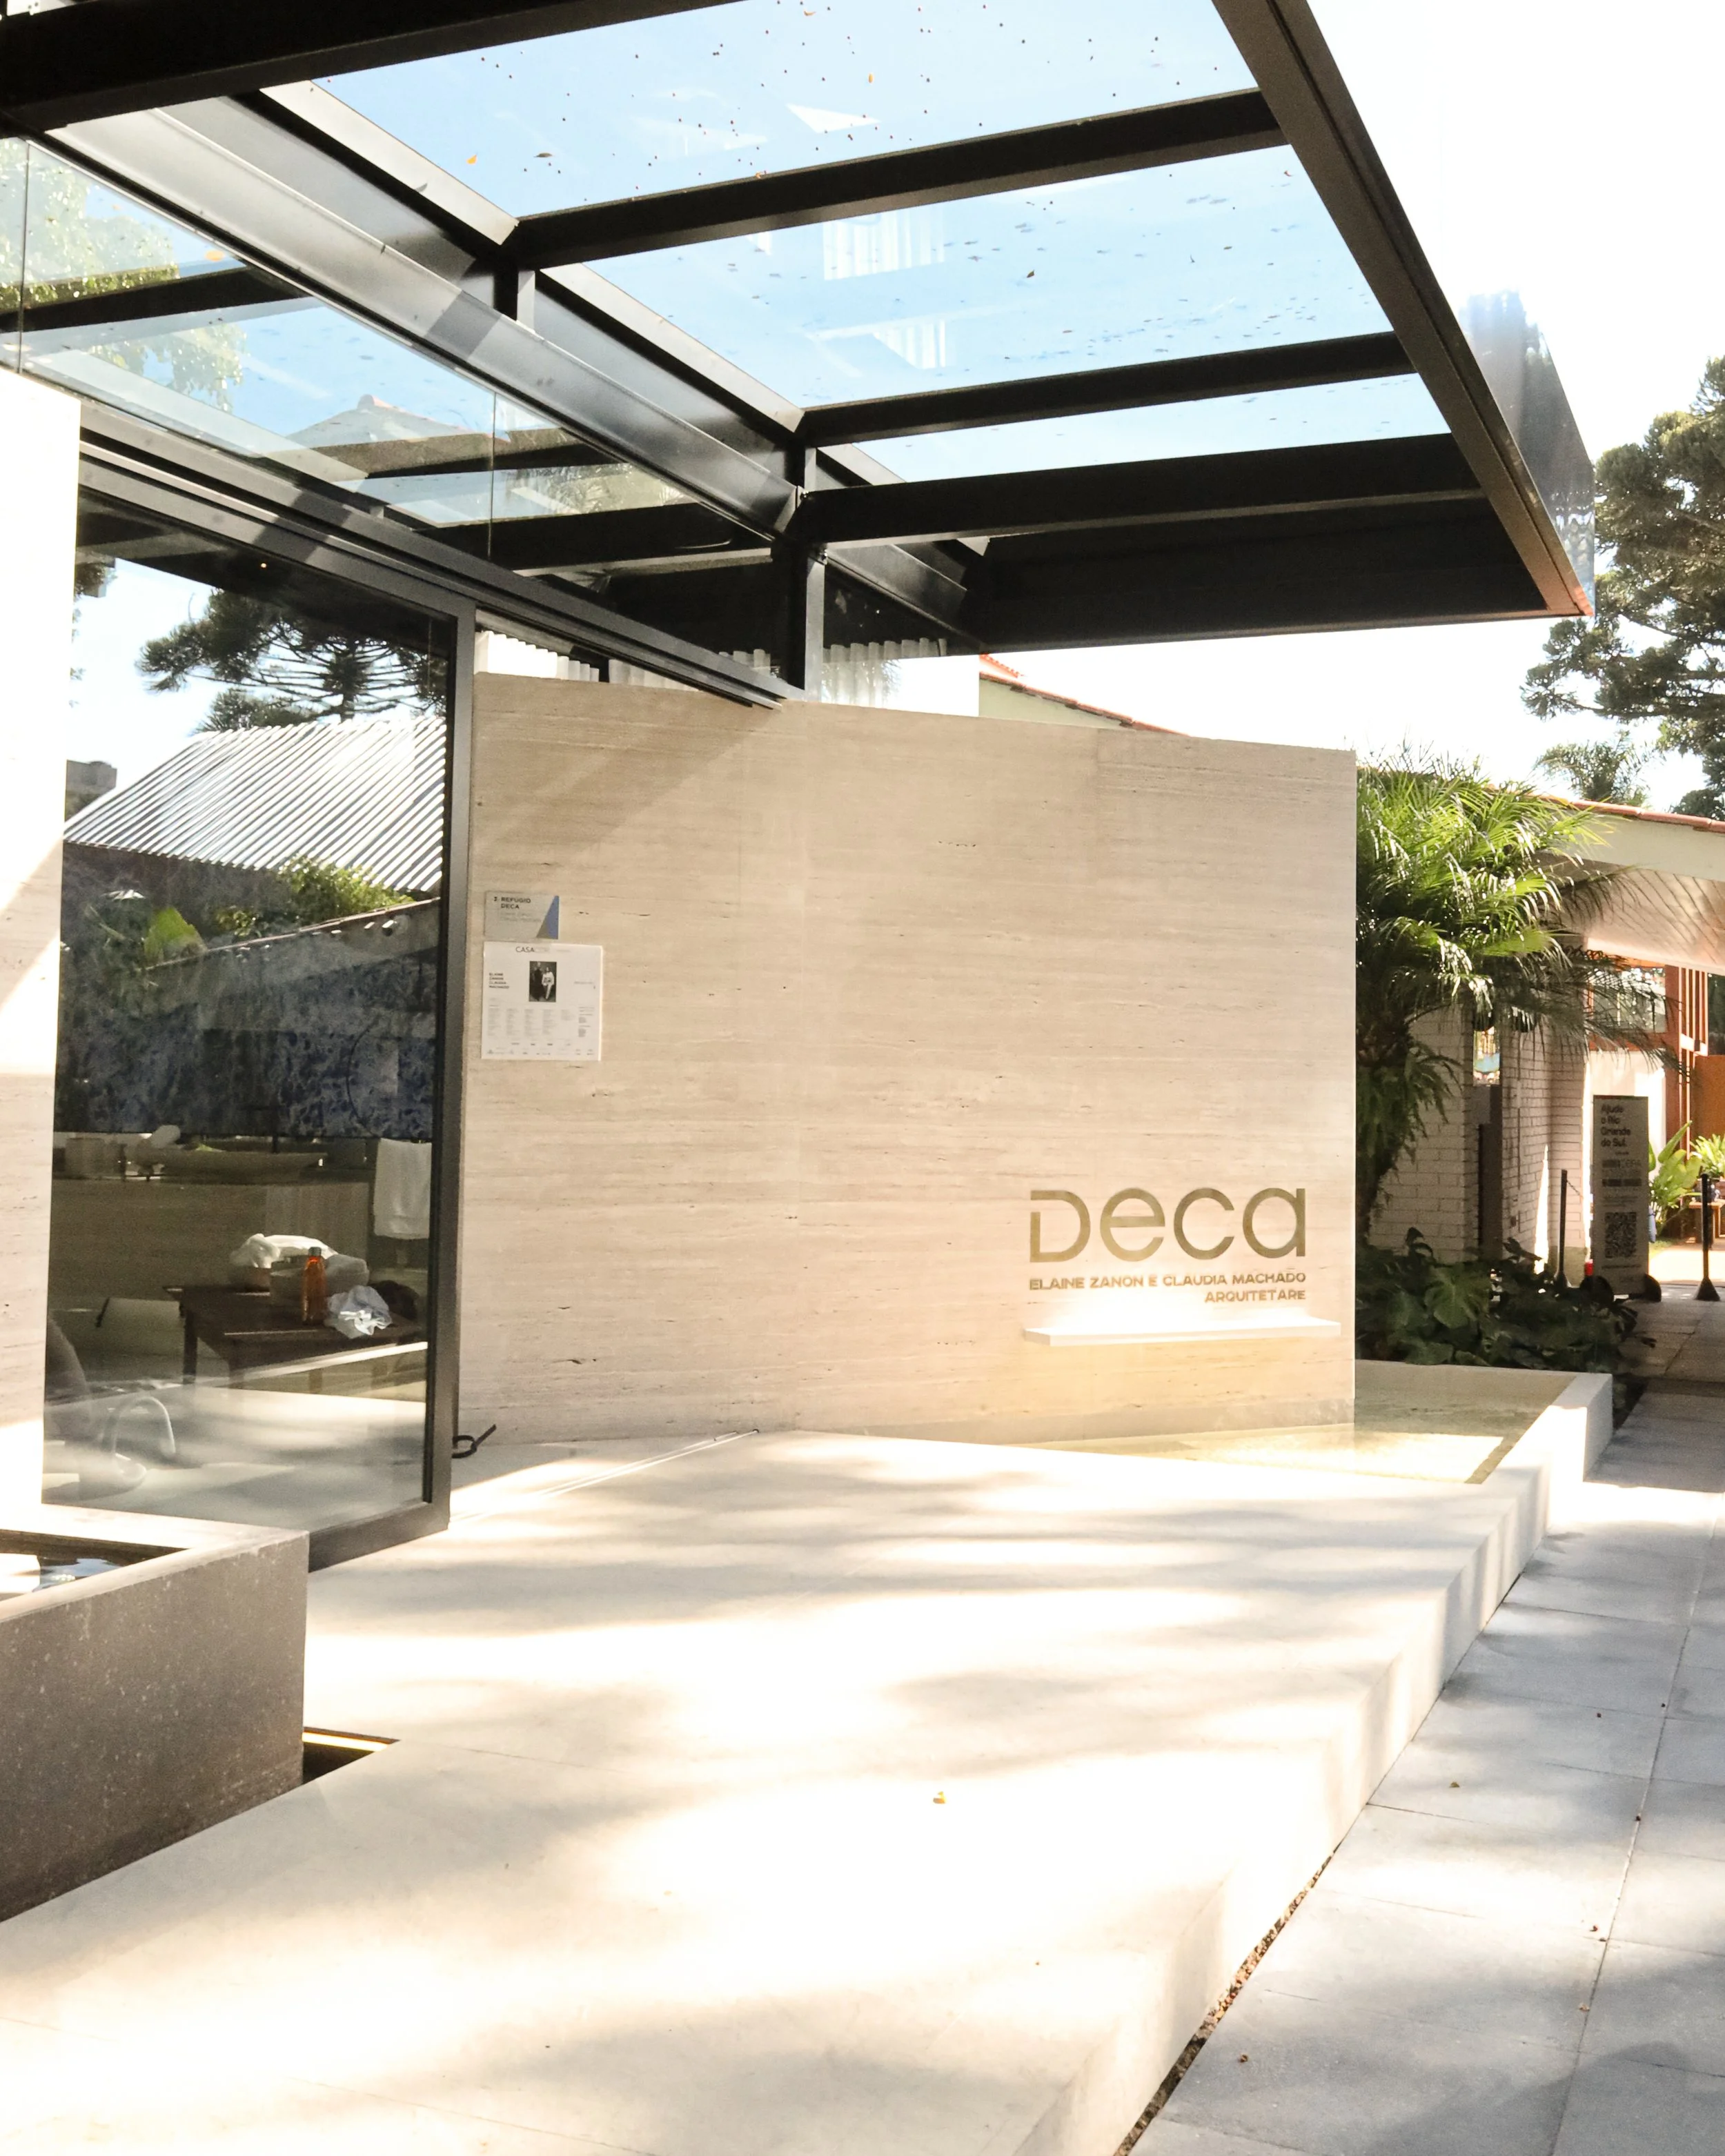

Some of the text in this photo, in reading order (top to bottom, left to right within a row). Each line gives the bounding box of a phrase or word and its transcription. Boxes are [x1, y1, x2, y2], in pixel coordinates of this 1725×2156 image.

[1029, 1272, 1306, 1290] ELAINE ZANON E CLAUDIA MACHADO
[1205, 1289, 1306, 1303] ARQUITETARE
